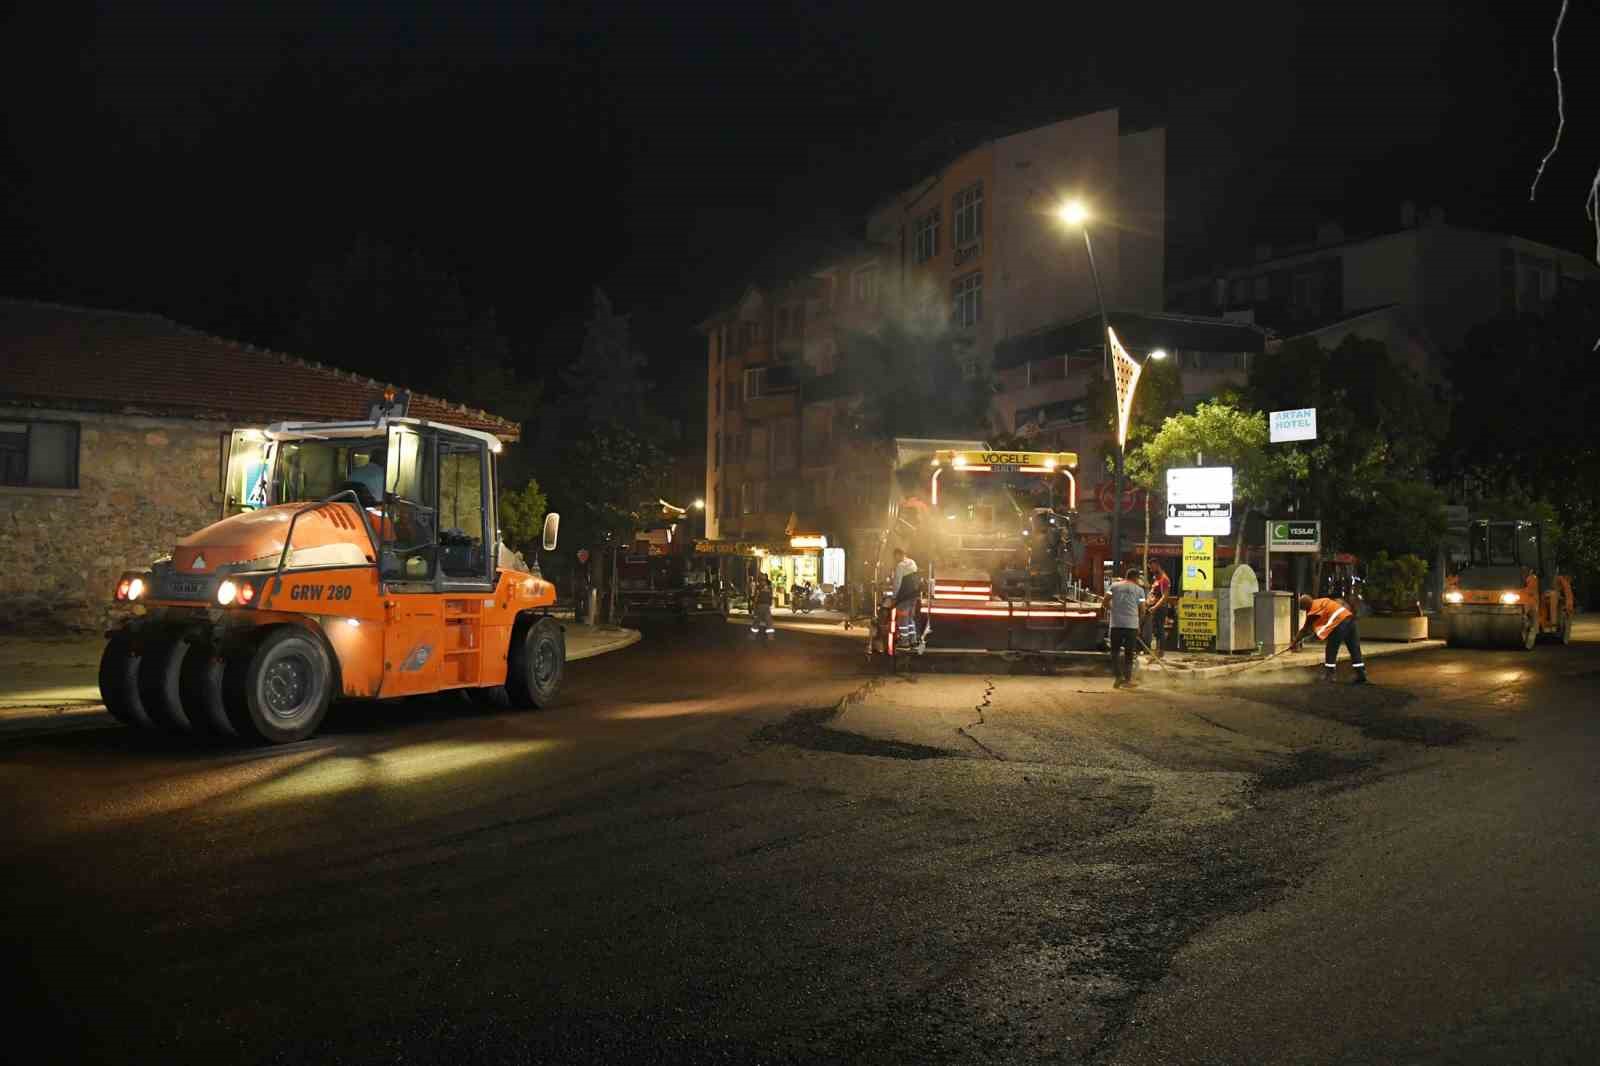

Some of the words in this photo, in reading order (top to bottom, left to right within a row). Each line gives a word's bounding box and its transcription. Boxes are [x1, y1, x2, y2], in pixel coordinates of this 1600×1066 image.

[1274, 419, 1313, 430] HOTEL
[290, 584, 324, 601] GRW
[327, 584, 352, 601] 280
